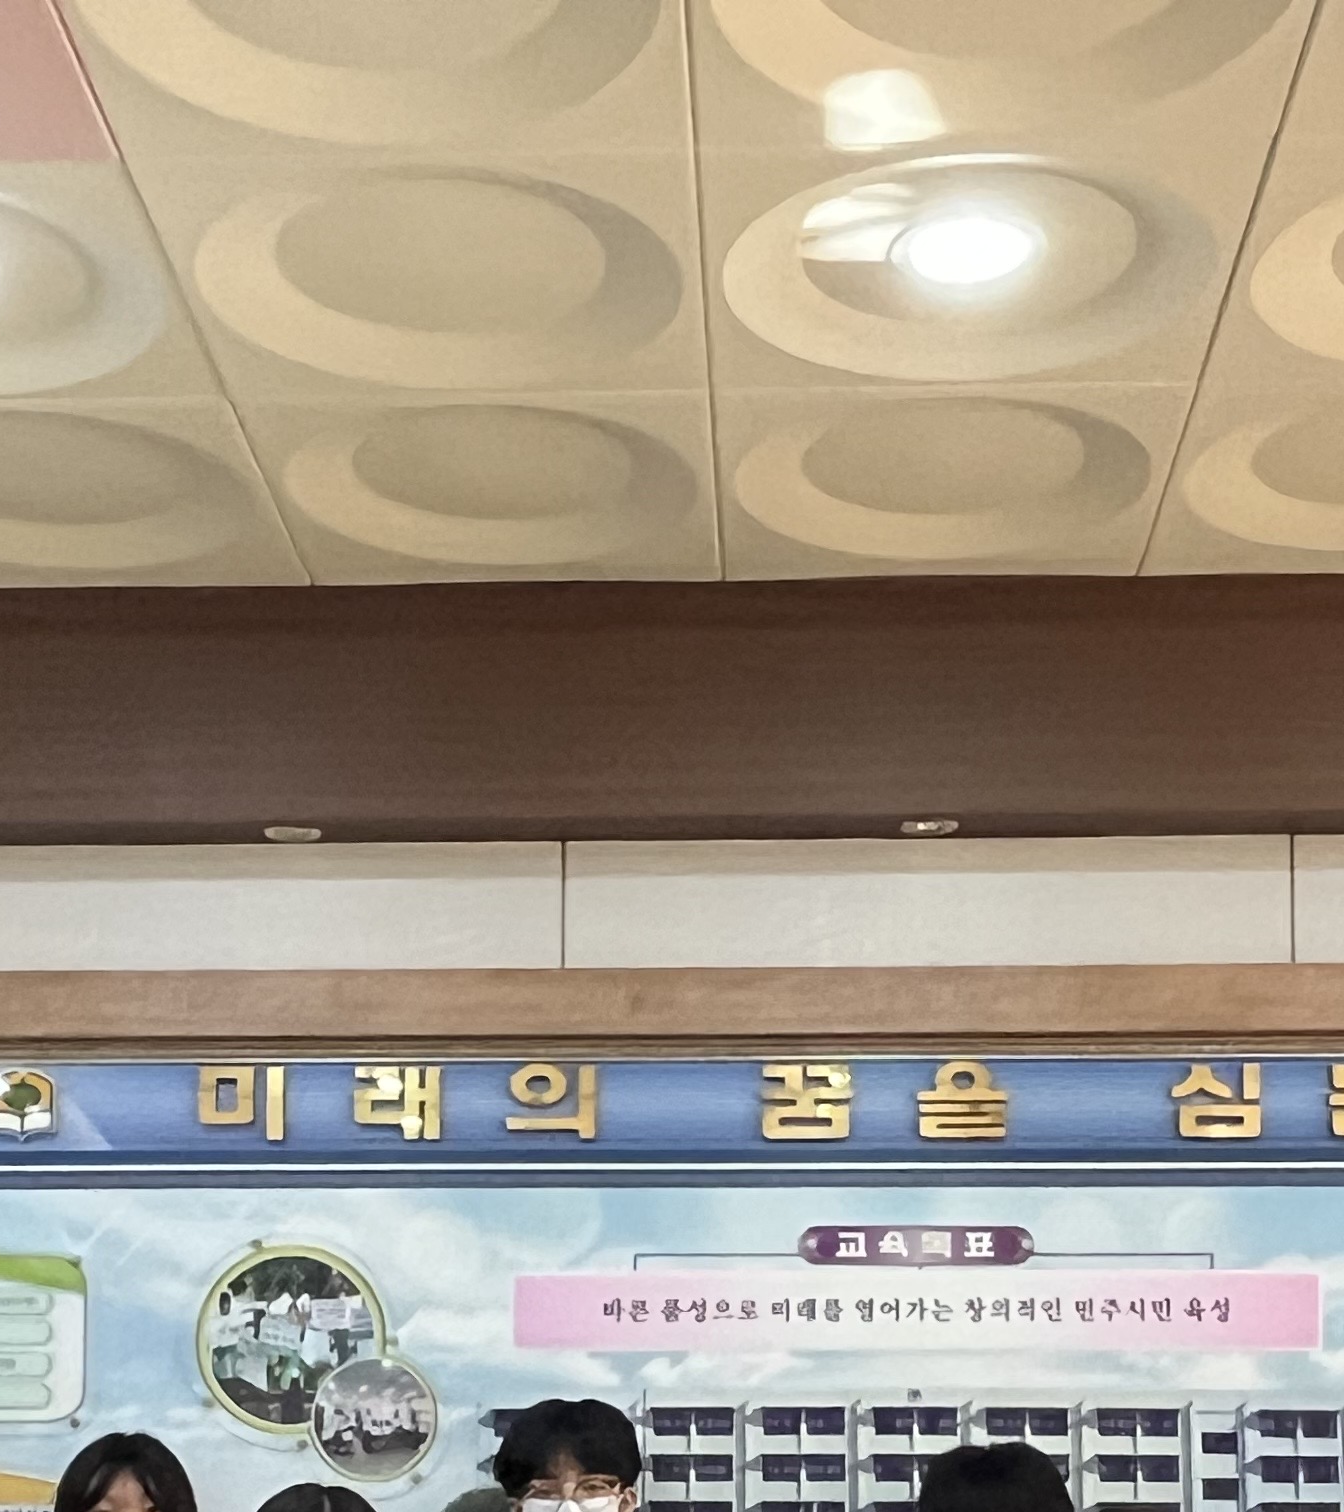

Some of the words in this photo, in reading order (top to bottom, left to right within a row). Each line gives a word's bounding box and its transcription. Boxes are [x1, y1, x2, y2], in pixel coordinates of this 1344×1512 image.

[197, 1060, 596, 1140] 미래의
[761, 1060, 1007, 1139] 꿈을
[835, 1230, 995, 1259] 교육목표
[604, 1297, 650, 1322] 바른
[771, 1297, 844, 1323] 미래를
[856, 1297, 954, 1323] 열어가는
[964, 1296, 1062, 1322] 창의적인
[1074, 1297, 1172, 1322] 민주시민
[1183, 1296, 1231, 1322] 육성
